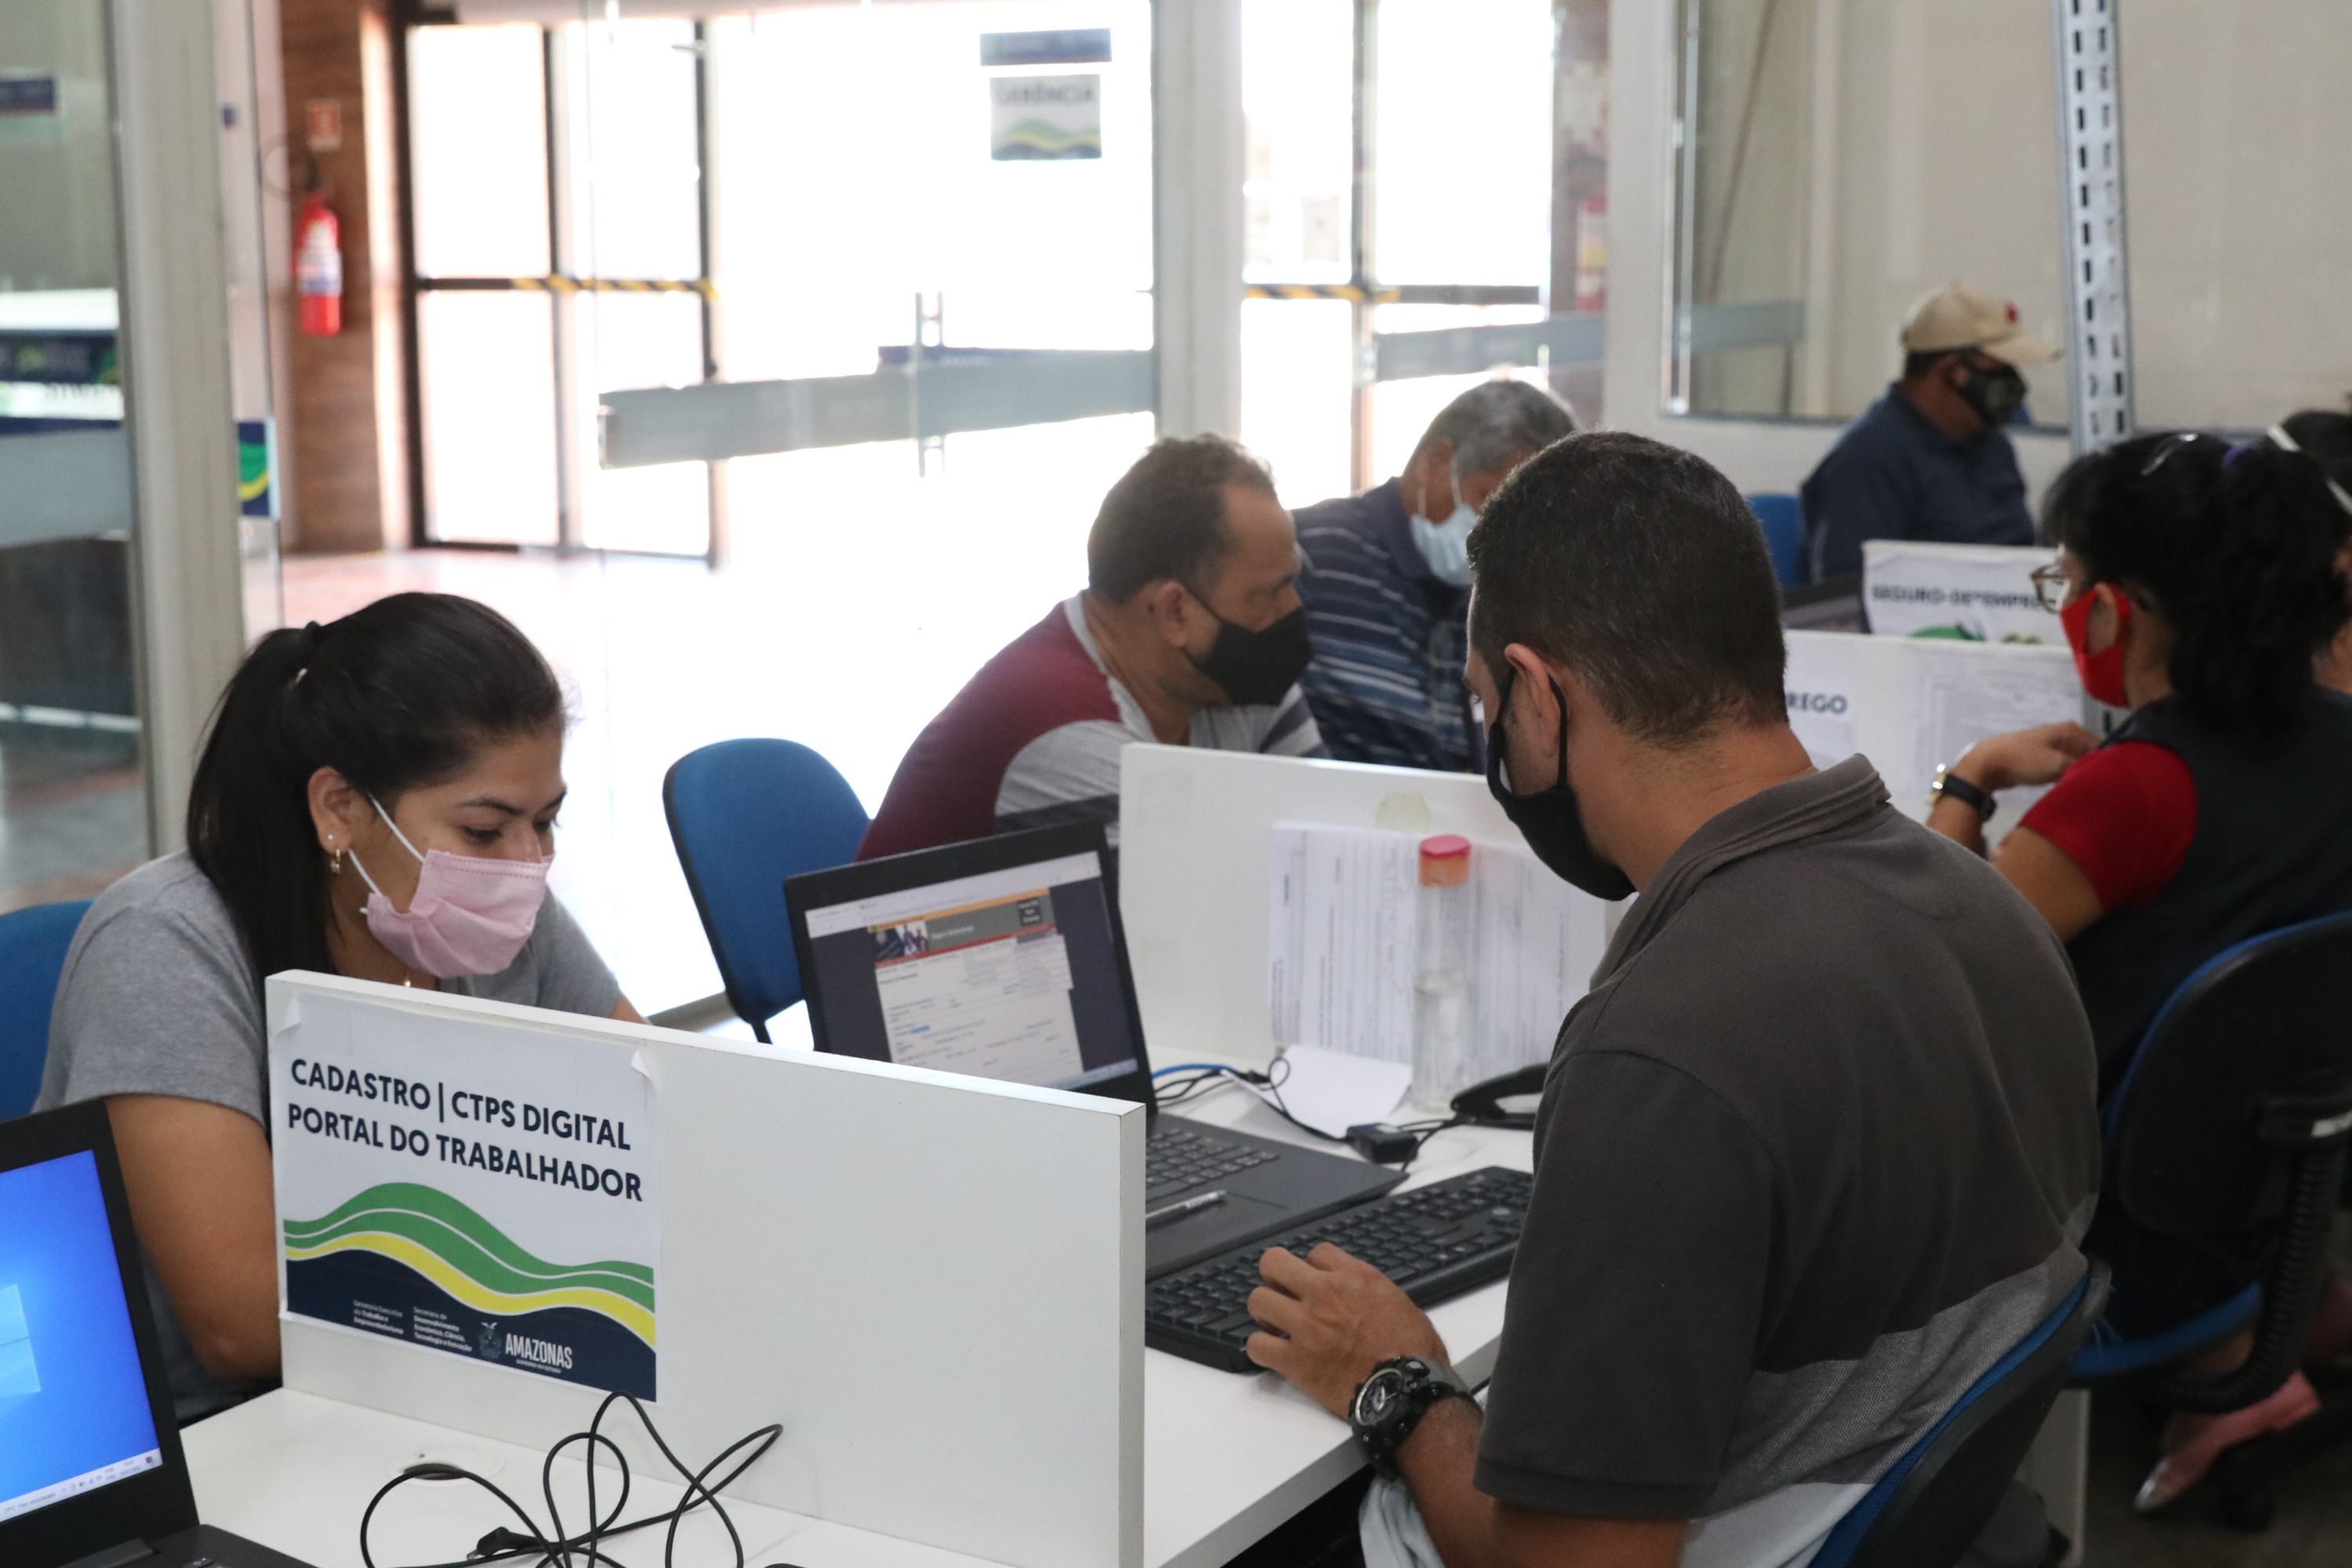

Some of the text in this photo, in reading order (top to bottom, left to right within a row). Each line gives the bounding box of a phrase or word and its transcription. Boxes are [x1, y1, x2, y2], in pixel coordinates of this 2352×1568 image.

[291, 1058, 431, 1110] CADASTRO
[452, 1091, 515, 1127] CTPS
[523, 1104, 630, 1150] DIGITAL
[289, 1103, 643, 1202] PORTAL DO TRABALHADOR
[505, 1333, 572, 1369] AMAZONAS
